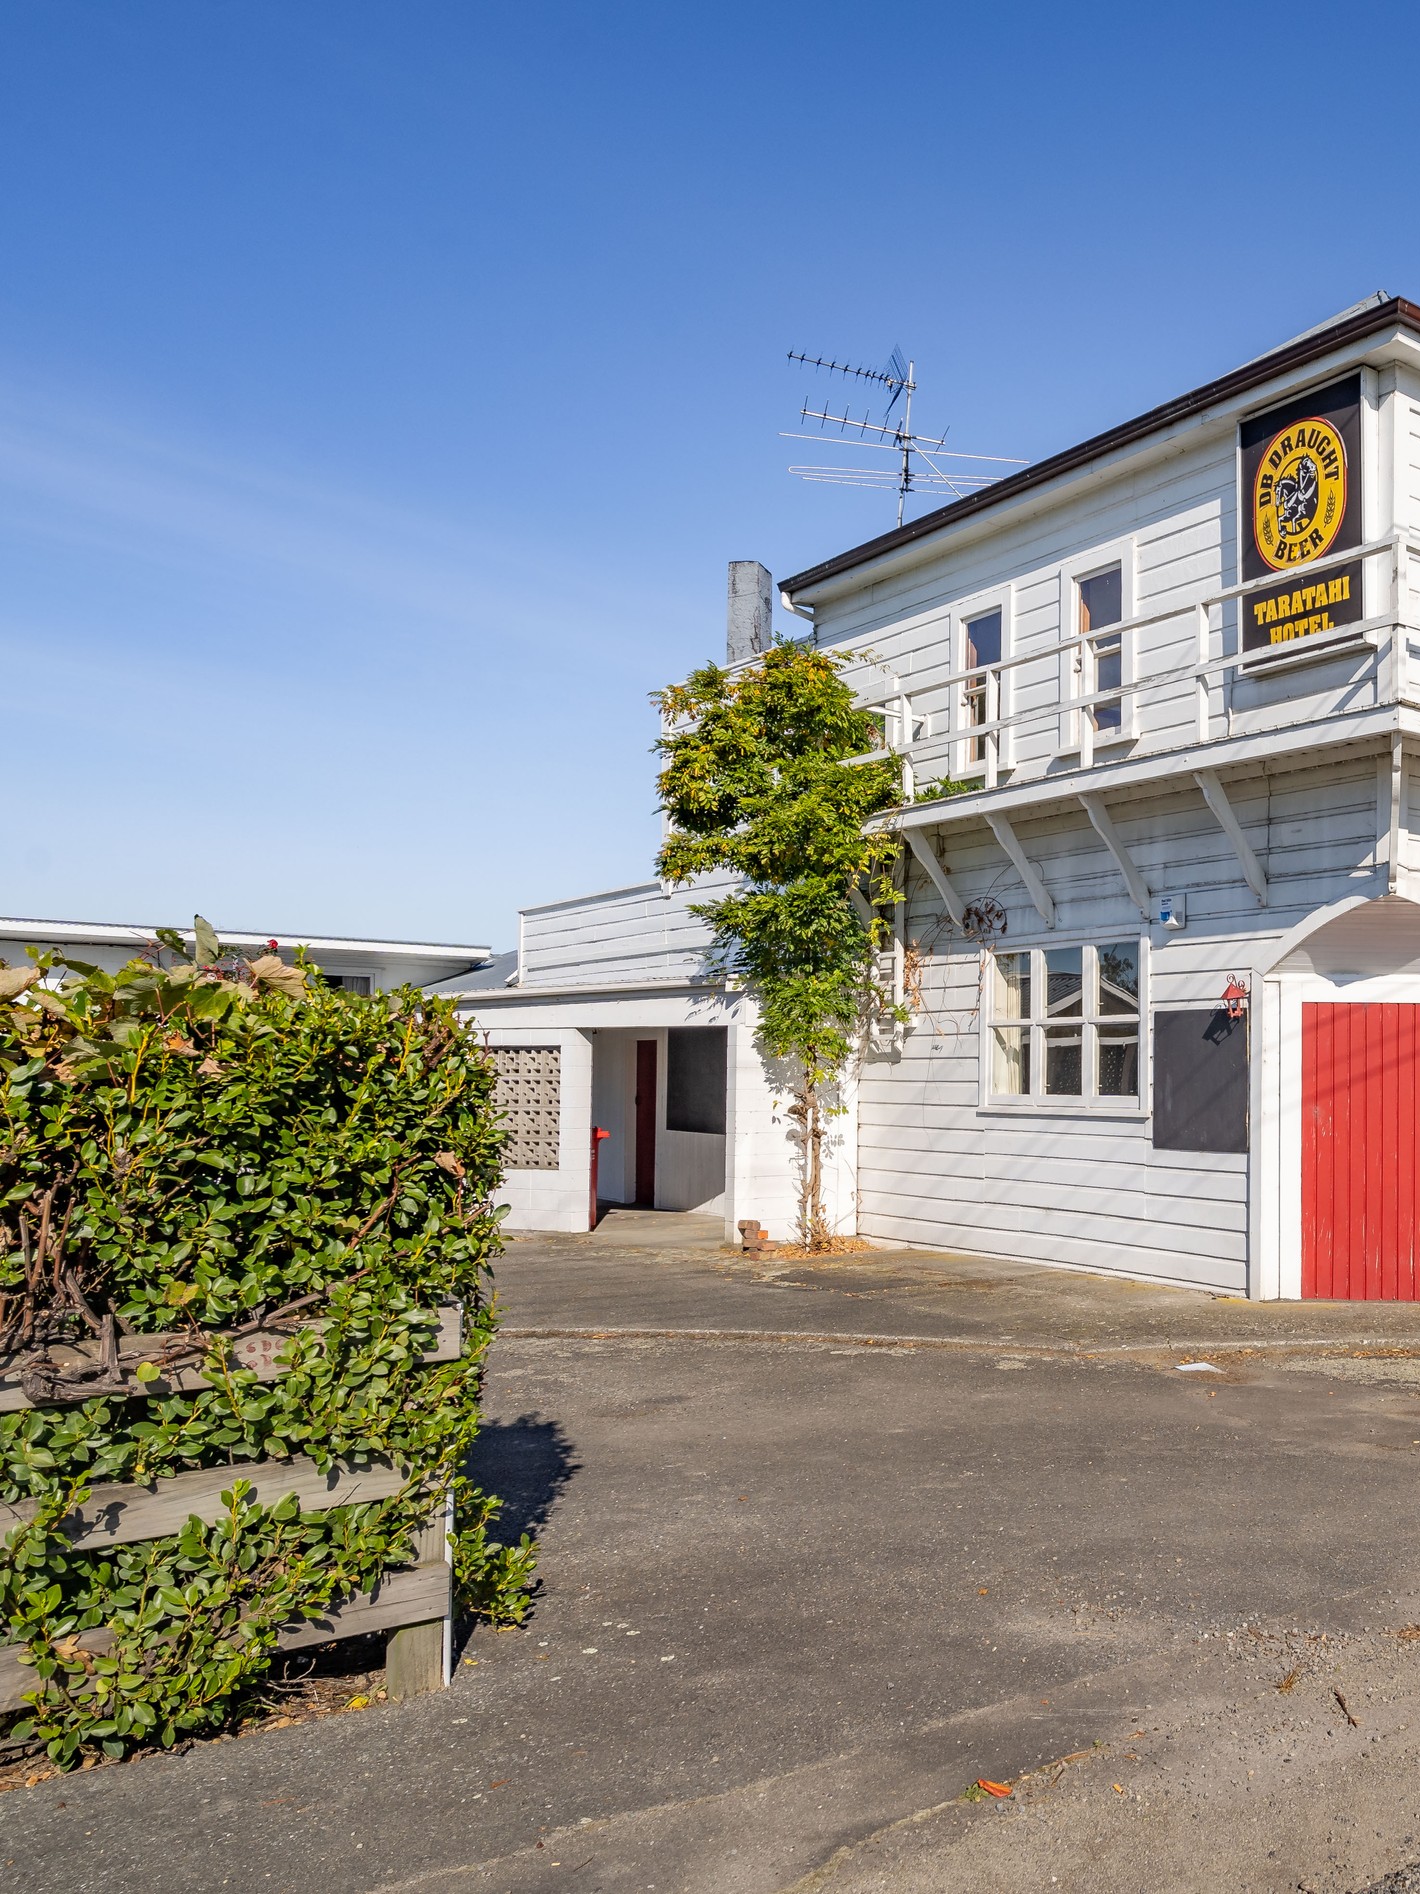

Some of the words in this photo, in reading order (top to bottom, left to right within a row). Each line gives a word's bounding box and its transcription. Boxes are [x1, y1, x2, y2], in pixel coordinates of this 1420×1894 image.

[1259, 473, 1274, 508] DB
[1268, 428, 1340, 482] DRAUGHT
[1274, 527, 1325, 563] BEER
[1254, 576, 1350, 625] TARATAHI
[1269, 612, 1335, 645] HOTEL
